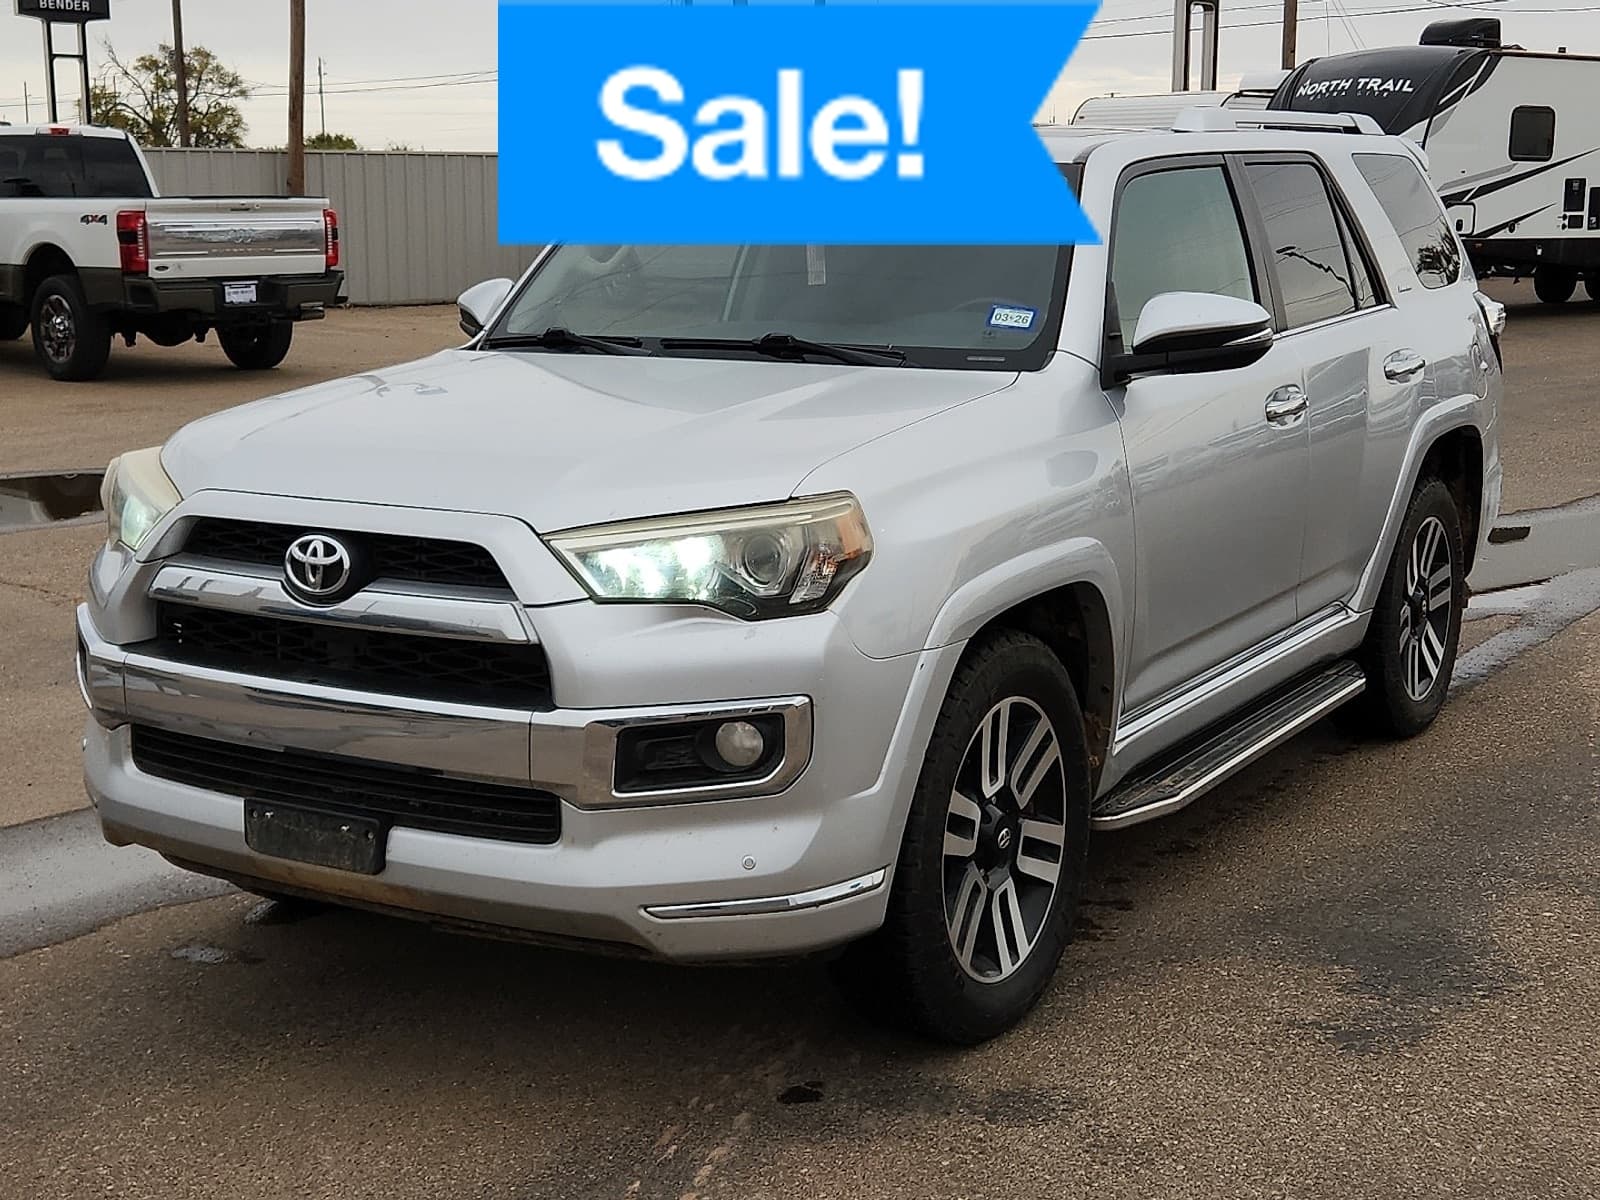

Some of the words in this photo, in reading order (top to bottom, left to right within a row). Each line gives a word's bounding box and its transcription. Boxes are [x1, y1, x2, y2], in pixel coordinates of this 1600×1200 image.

[39, 0, 90, 11] BENDER
[1296, 78, 1353, 97] NORTH
[1357, 77, 1415, 93] TRAIL
